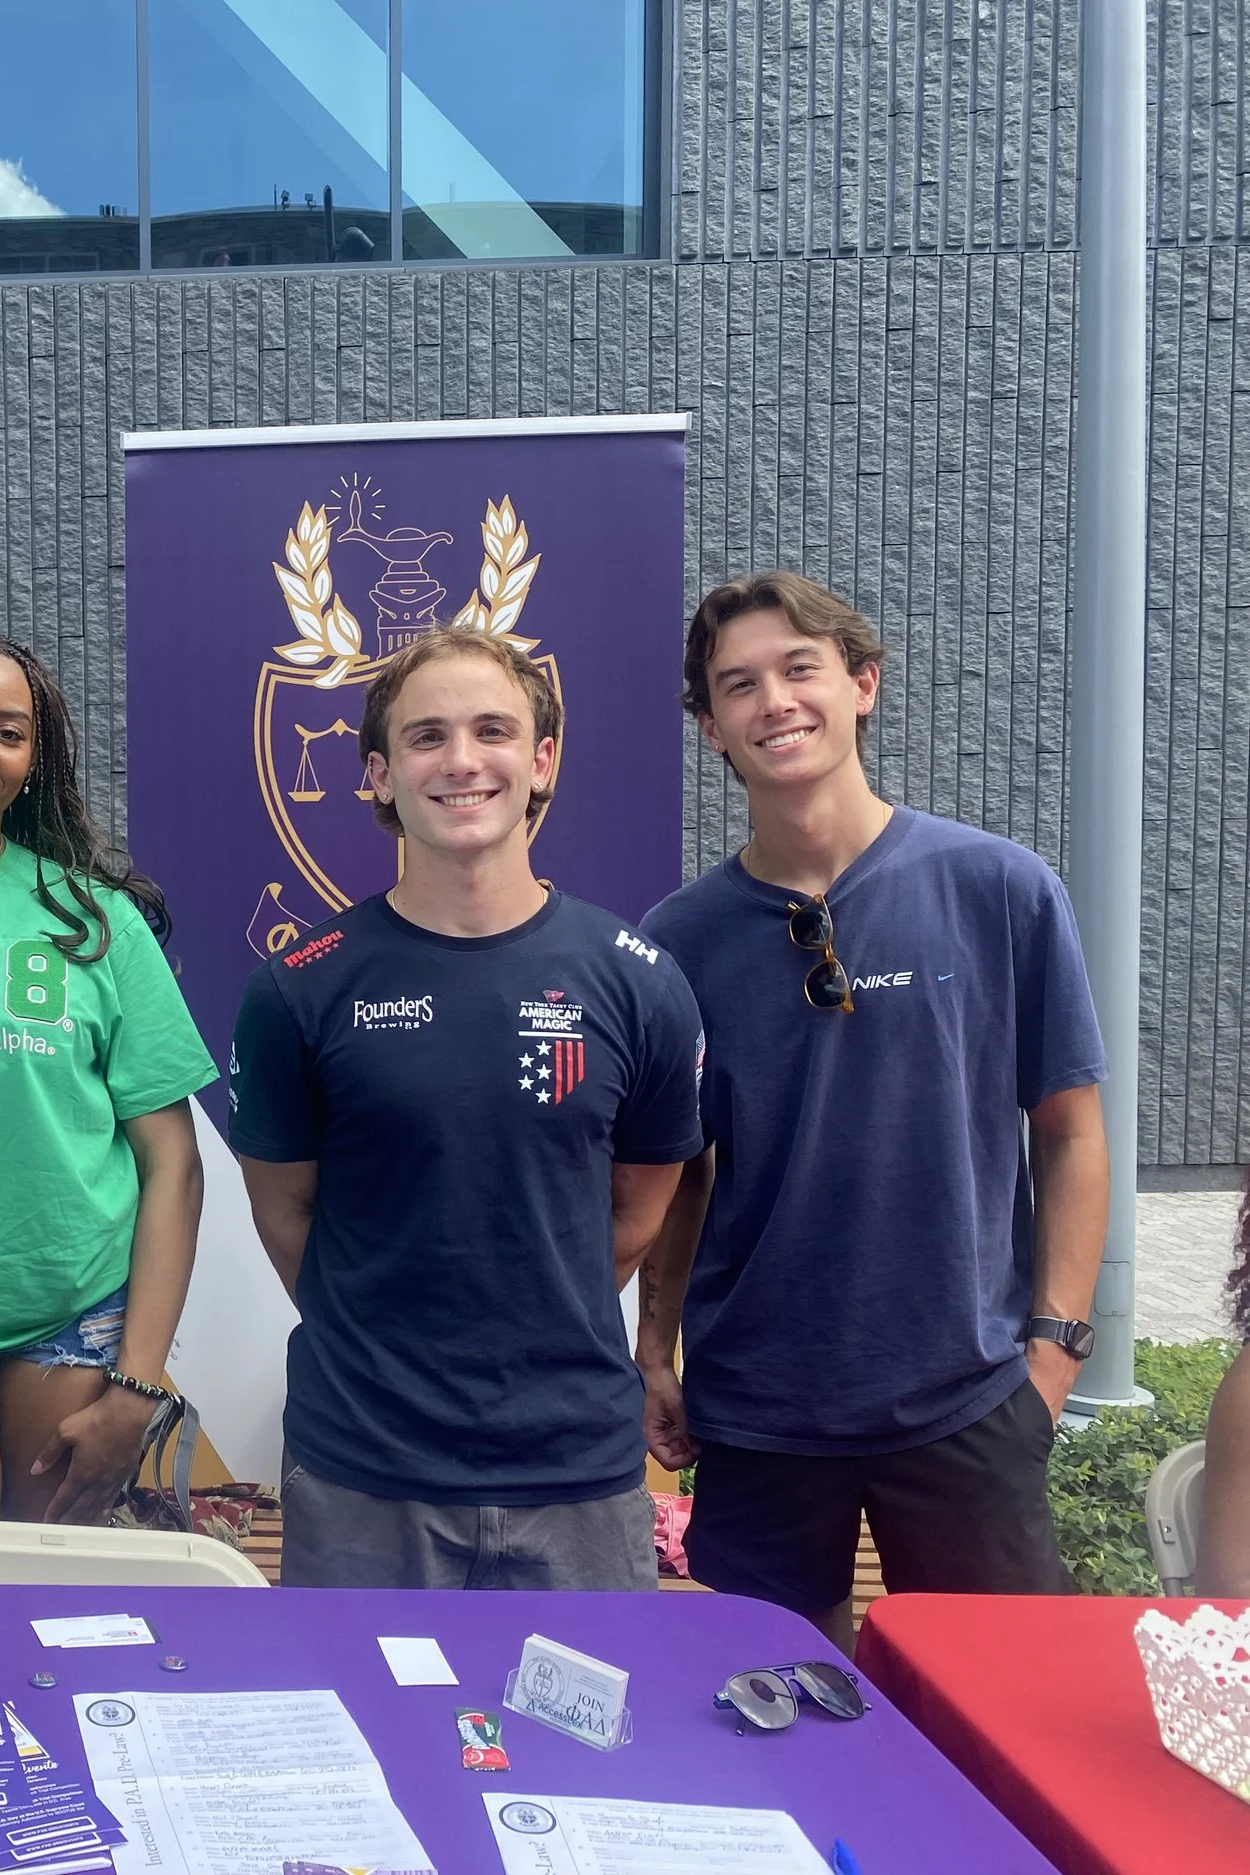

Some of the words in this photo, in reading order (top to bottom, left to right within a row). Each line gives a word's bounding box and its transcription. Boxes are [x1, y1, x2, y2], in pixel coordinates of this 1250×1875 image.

[852, 971, 914, 991] NIKE
[519, 1007, 582, 1021] AMERICAN
[365, 1020, 421, 1030] Brewing
[532, 1018, 573, 1031] MAGIC
[576, 1692, 605, 1713] JOIN
[131, 1819, 162, 1867] Interested
